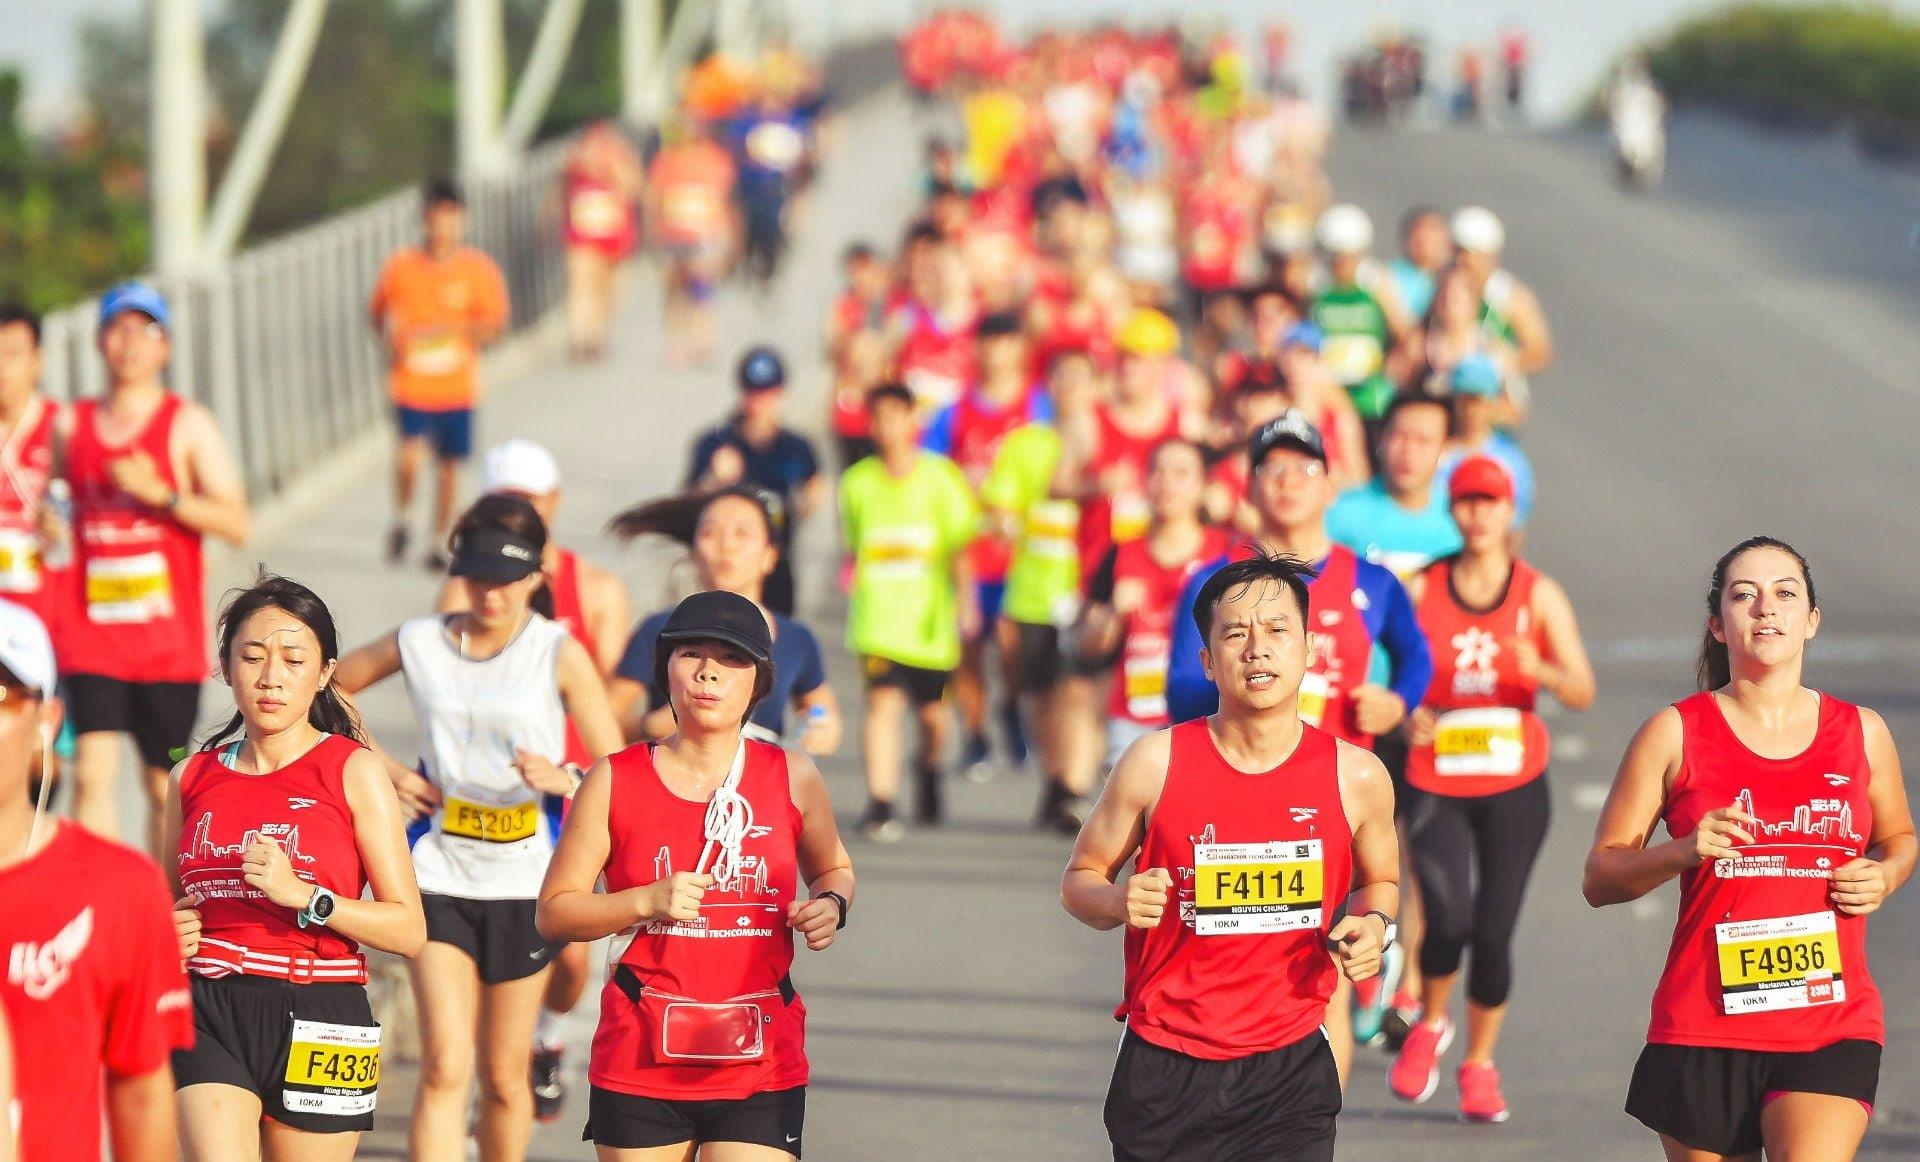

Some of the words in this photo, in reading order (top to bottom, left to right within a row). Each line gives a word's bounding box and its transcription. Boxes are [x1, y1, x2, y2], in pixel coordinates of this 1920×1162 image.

[1735, 867, 1784, 877] MARATHON
[1786, 868, 1834, 878] TECHCOM
[1216, 869, 1305, 900] F4114
[246, 890, 268, 898] TEC
[1232, 906, 1263, 914] NGUYEN
[1263, 905, 1289, 913] CHUNG
[1214, 920, 1239, 929] 10KM
[708, 929, 773, 938] TECHCOMBANK
[1739, 941, 1825, 977] F4936
[1742, 996, 1768, 1006] 10KM
[307, 1050, 379, 1082] F4336
[299, 1098, 323, 1107] 10KM
